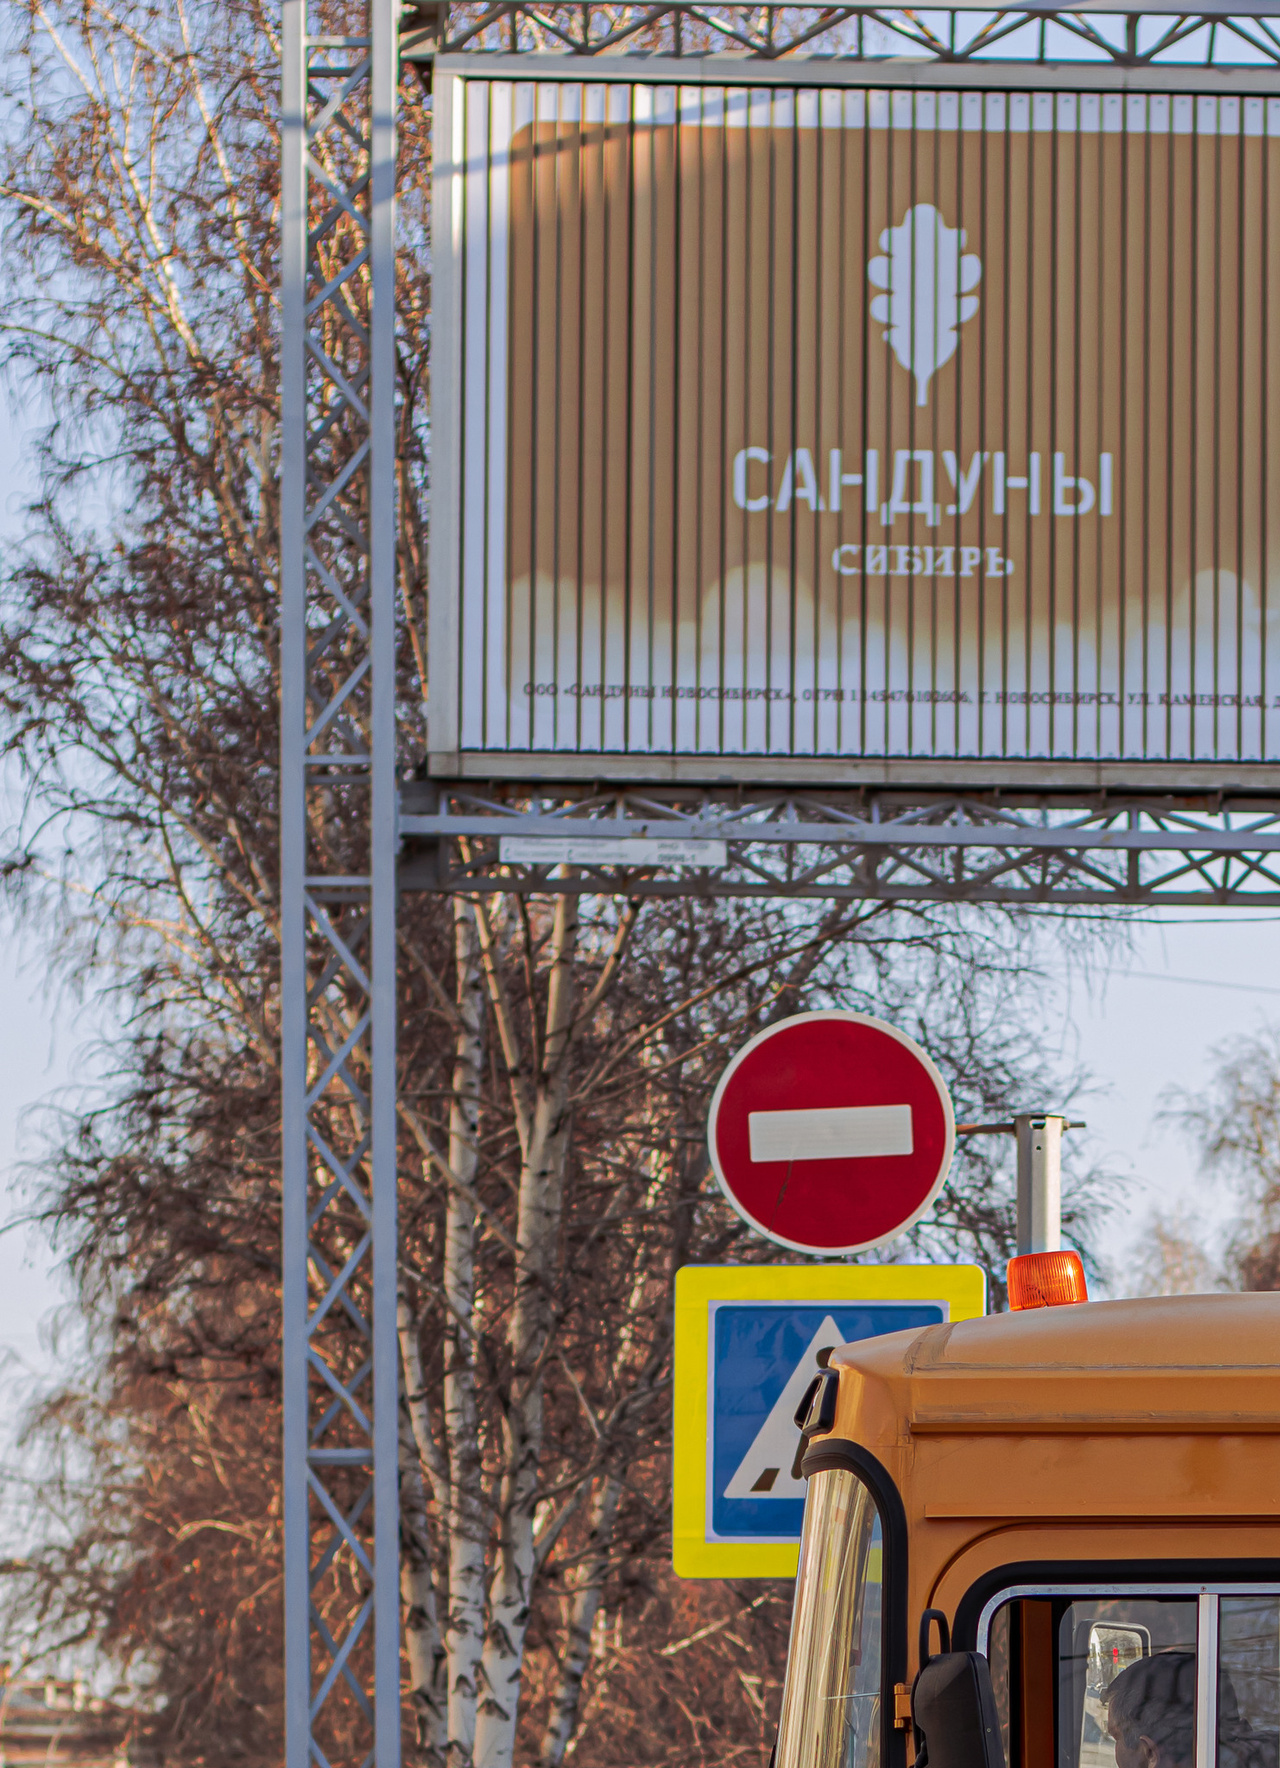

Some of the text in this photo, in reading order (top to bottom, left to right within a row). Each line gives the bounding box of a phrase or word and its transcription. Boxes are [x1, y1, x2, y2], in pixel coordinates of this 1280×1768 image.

[733, 446, 1113, 527] САНДУНЫ
[832, 543, 1015, 577] СИБИРЬ
[523, 682, 559, 697] ООО
